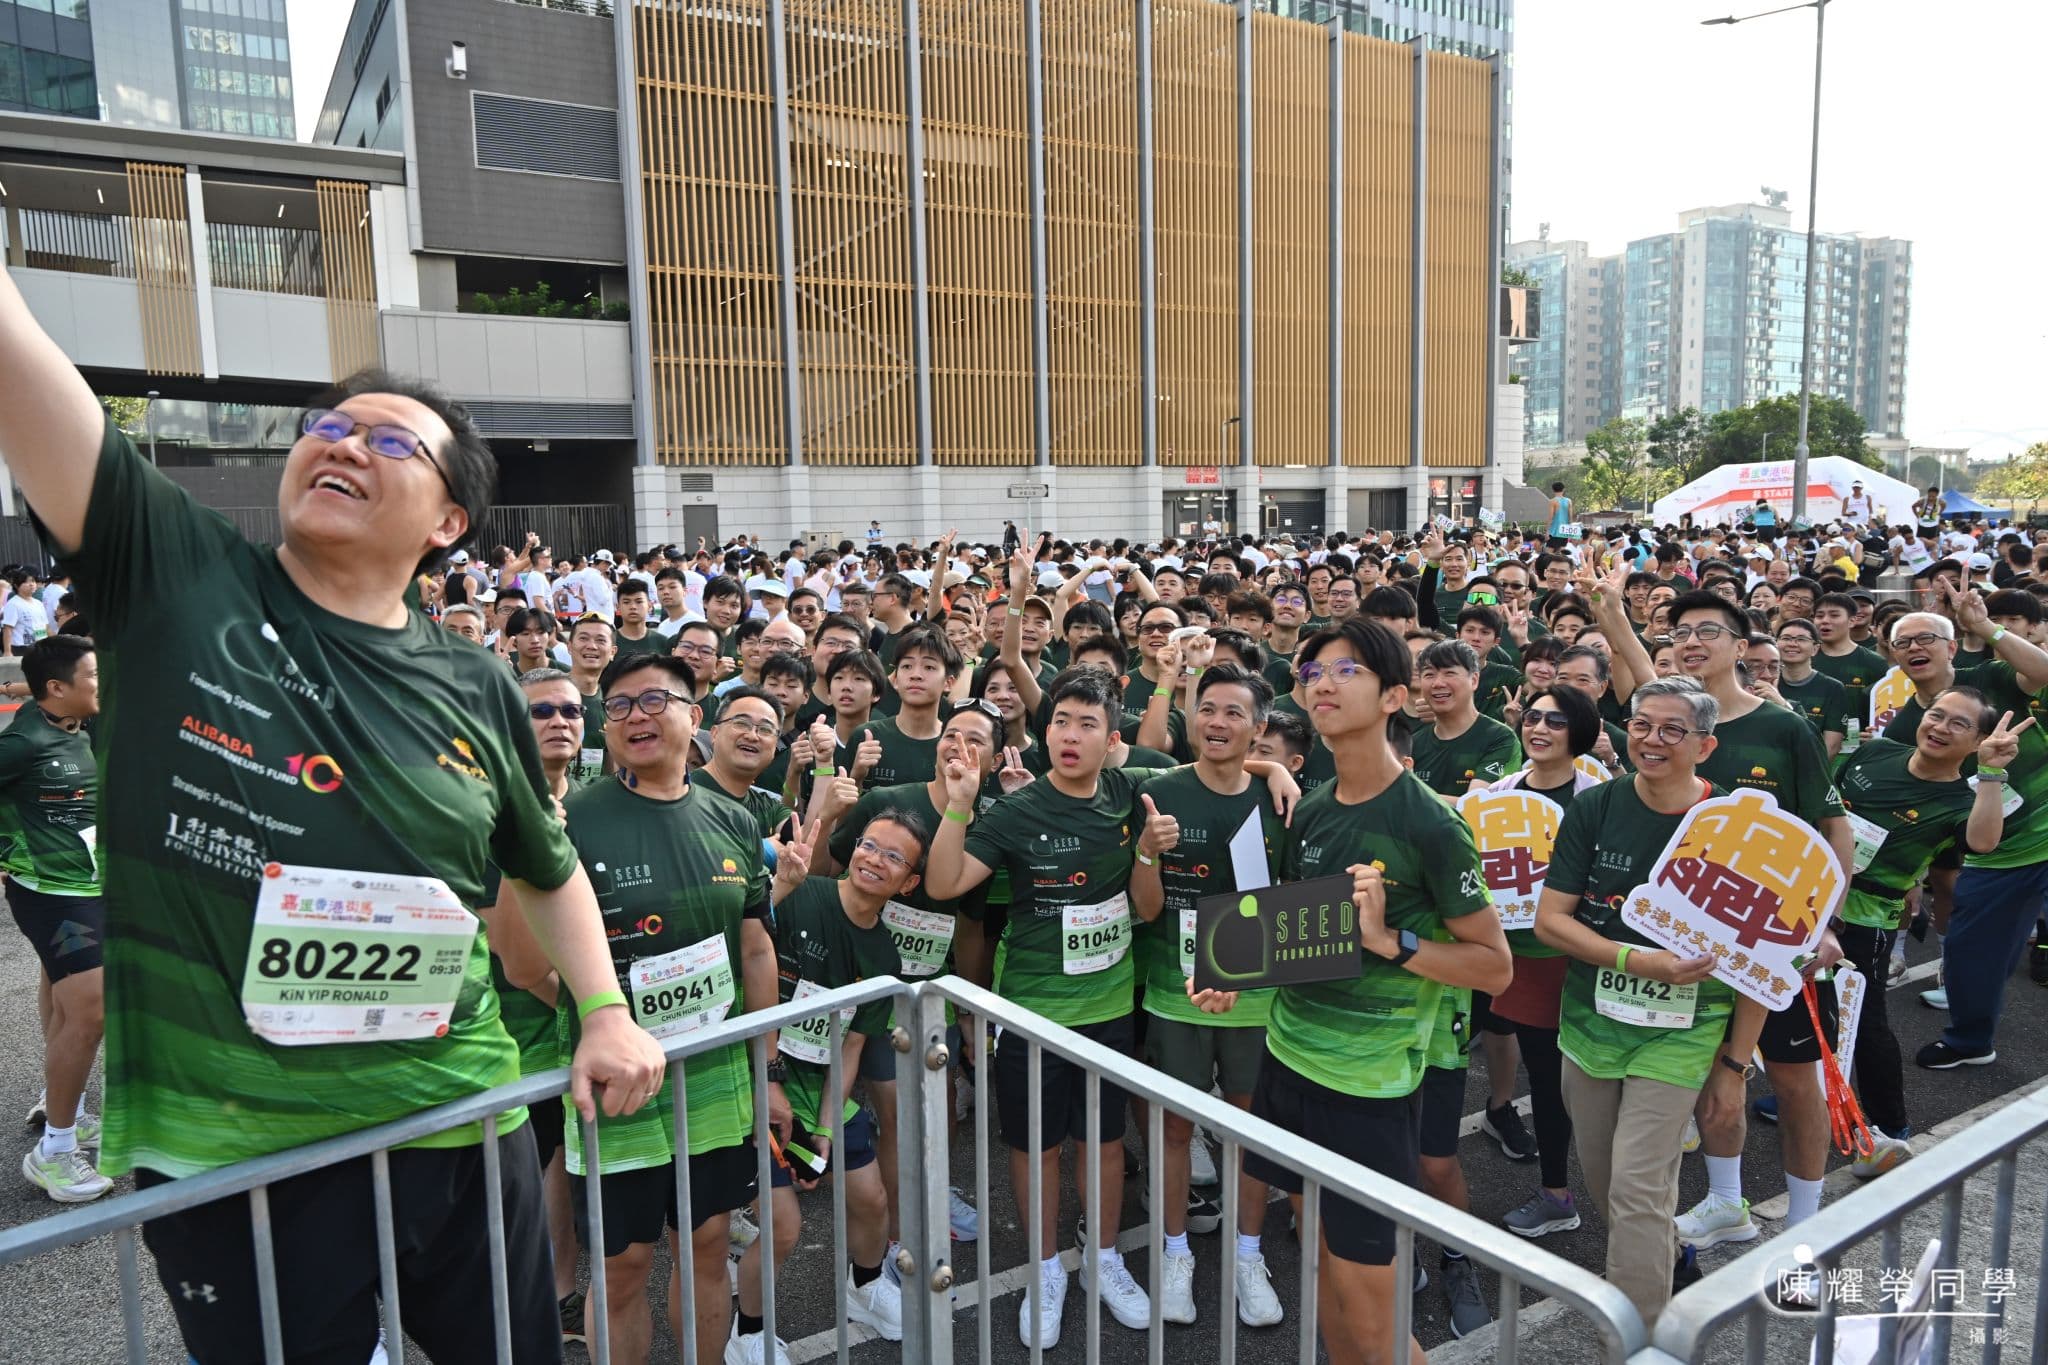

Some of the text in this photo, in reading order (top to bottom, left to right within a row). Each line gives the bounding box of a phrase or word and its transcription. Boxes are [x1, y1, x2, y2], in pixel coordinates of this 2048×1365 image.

[189, 671, 272, 721] Founding Sponsor
[182, 715, 254, 758] ALIBABA
[266, 767, 299, 786] FUND
[167, 812, 265, 870] LEE HYSAN
[1601, 851, 1632, 867] SEED
[616, 864, 651, 881] SEED
[1276, 901, 1353, 943] SEED
[889, 929, 934, 954] 0801
[1068, 925, 1119, 950] 81042
[1634, 897, 1791, 996] 香港中文中學聯會
[258, 938, 422, 981] 80222
[429, 964, 462, 976] 09:30
[1275, 941, 1353, 962] FOUNDATION
[308, 990, 330, 1001] YIP
[332, 990, 389, 1002] RONALD
[642, 976, 714, 1015] 80941
[1601, 970, 1671, 1000] 80142
[661, 1004, 702, 1022] CHUN HUNG
[1631, 999, 1646, 1008] SING
